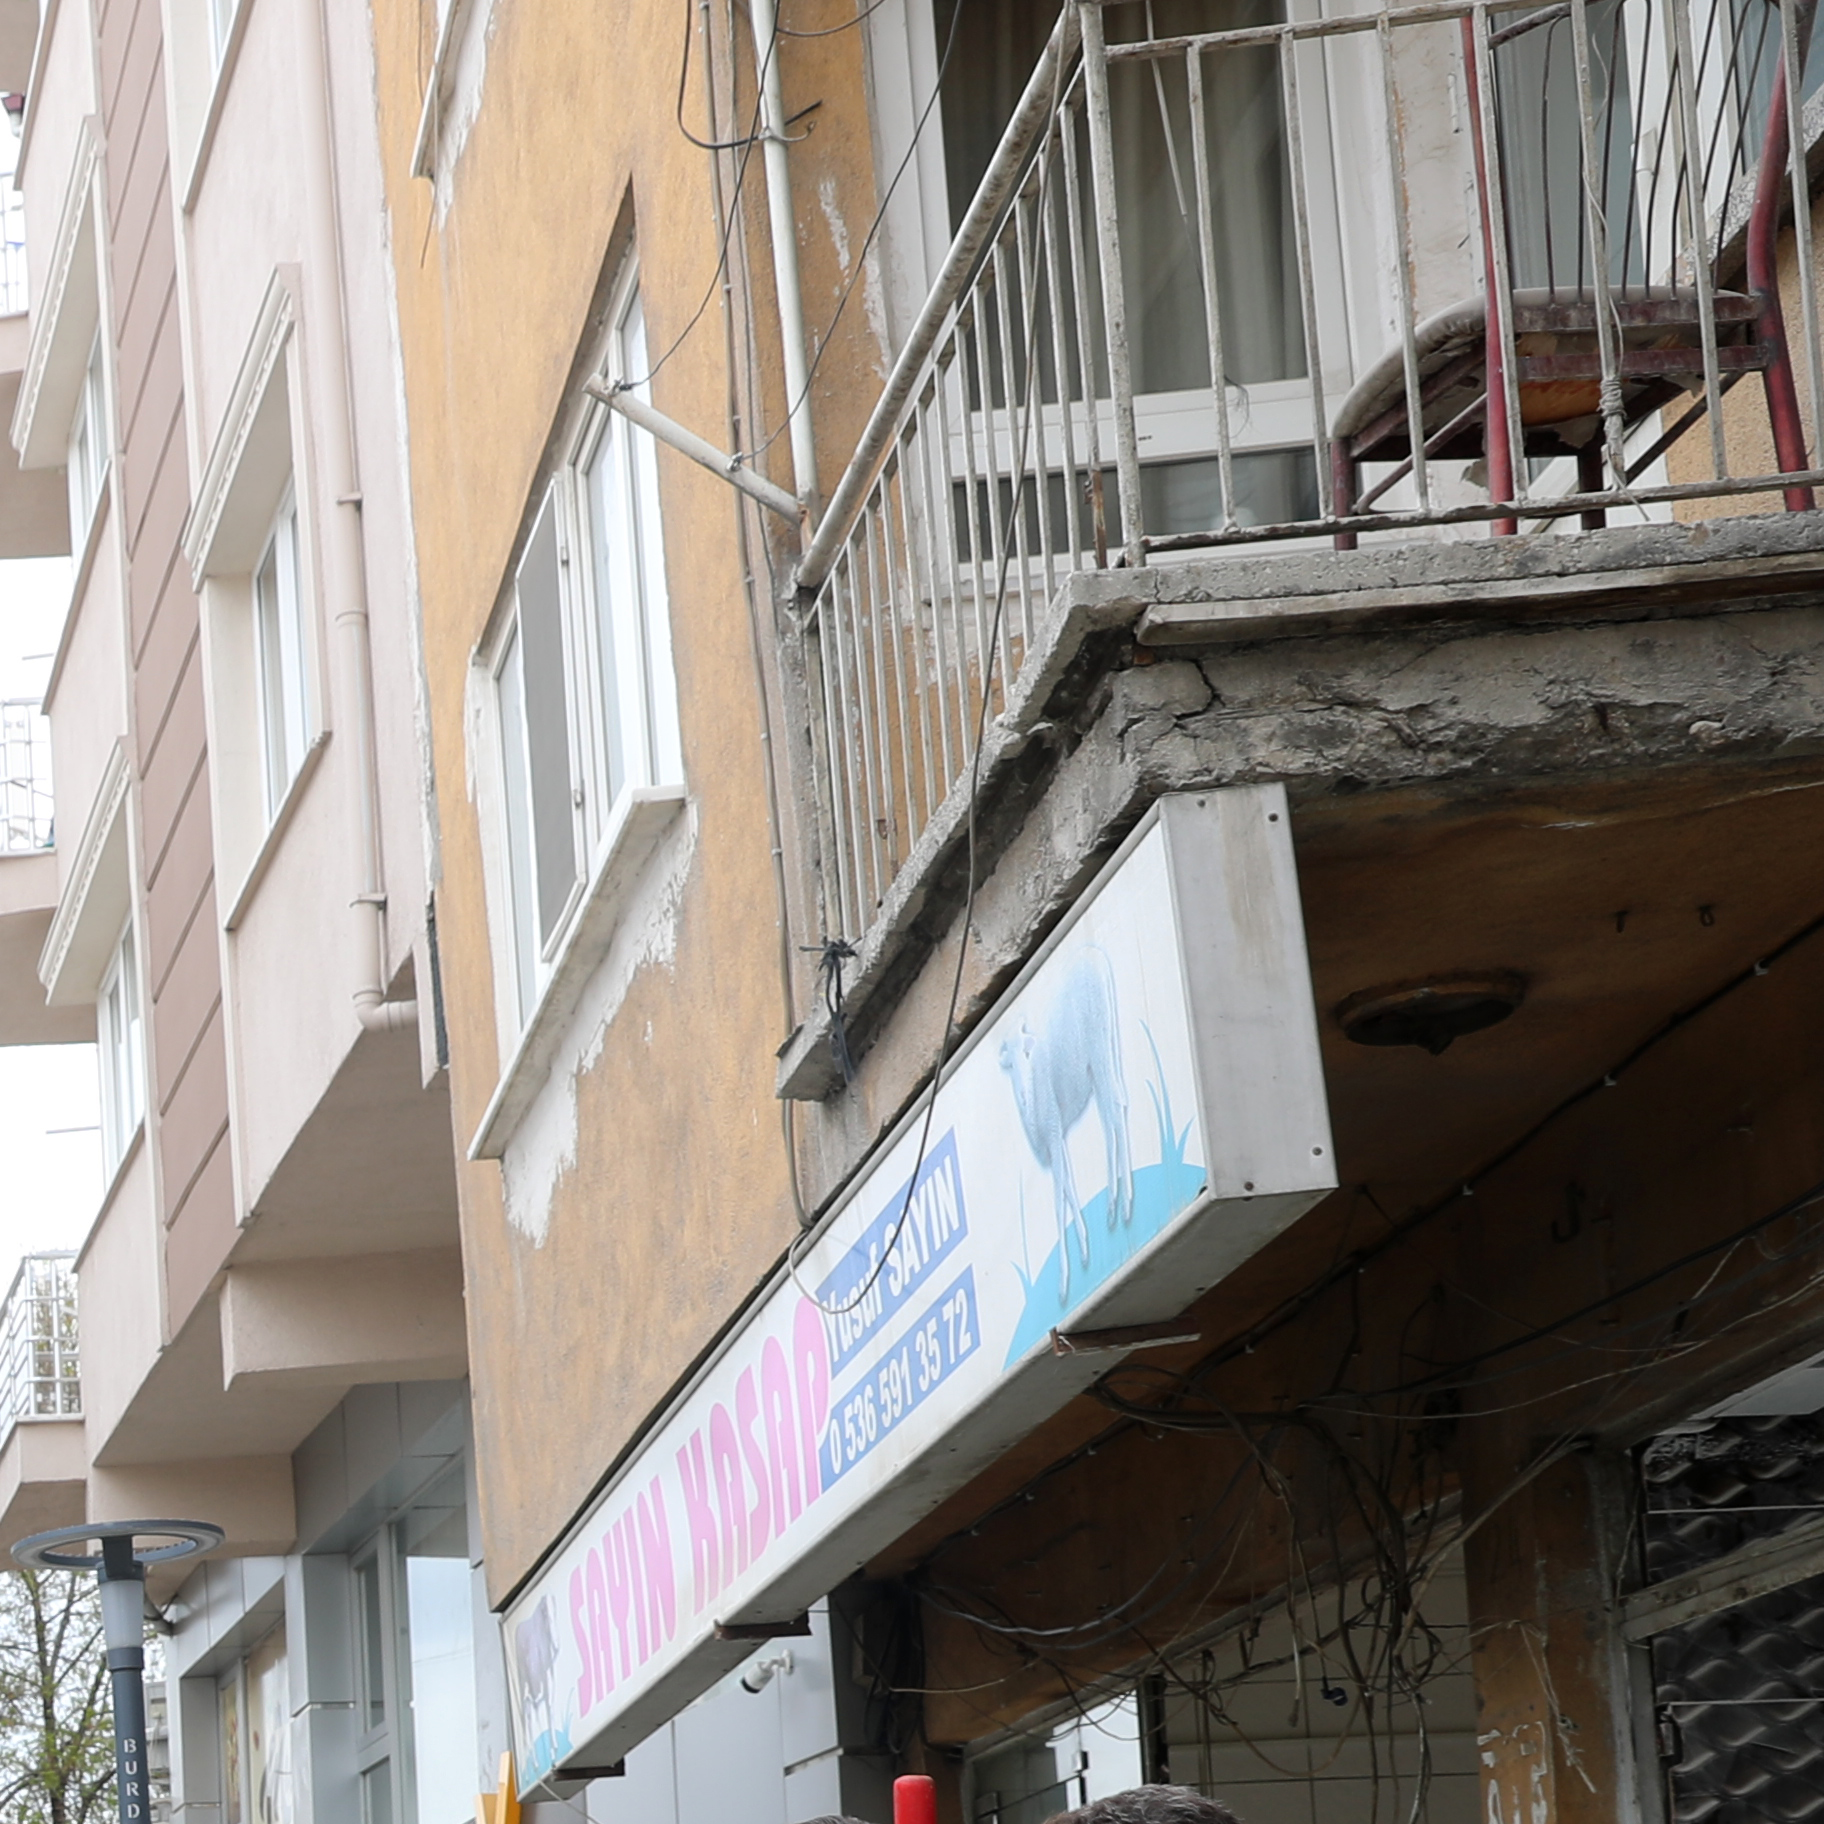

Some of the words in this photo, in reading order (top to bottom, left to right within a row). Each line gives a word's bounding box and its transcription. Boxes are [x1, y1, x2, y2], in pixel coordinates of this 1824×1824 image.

[823, 1241, 884, 1363] Yusuf
[883, 1155, 960, 1298] SAYIN
[830, 1410, 843, 1476] 0
[843, 1383, 877, 1463] 536
[878, 1350, 914, 1430] 591
[915, 1315, 942, 1393] 35
[943, 1287, 972, 1366] 72
[568, 1475, 679, 1719] SAYIN
[676, 1294, 833, 1617] KASAP
